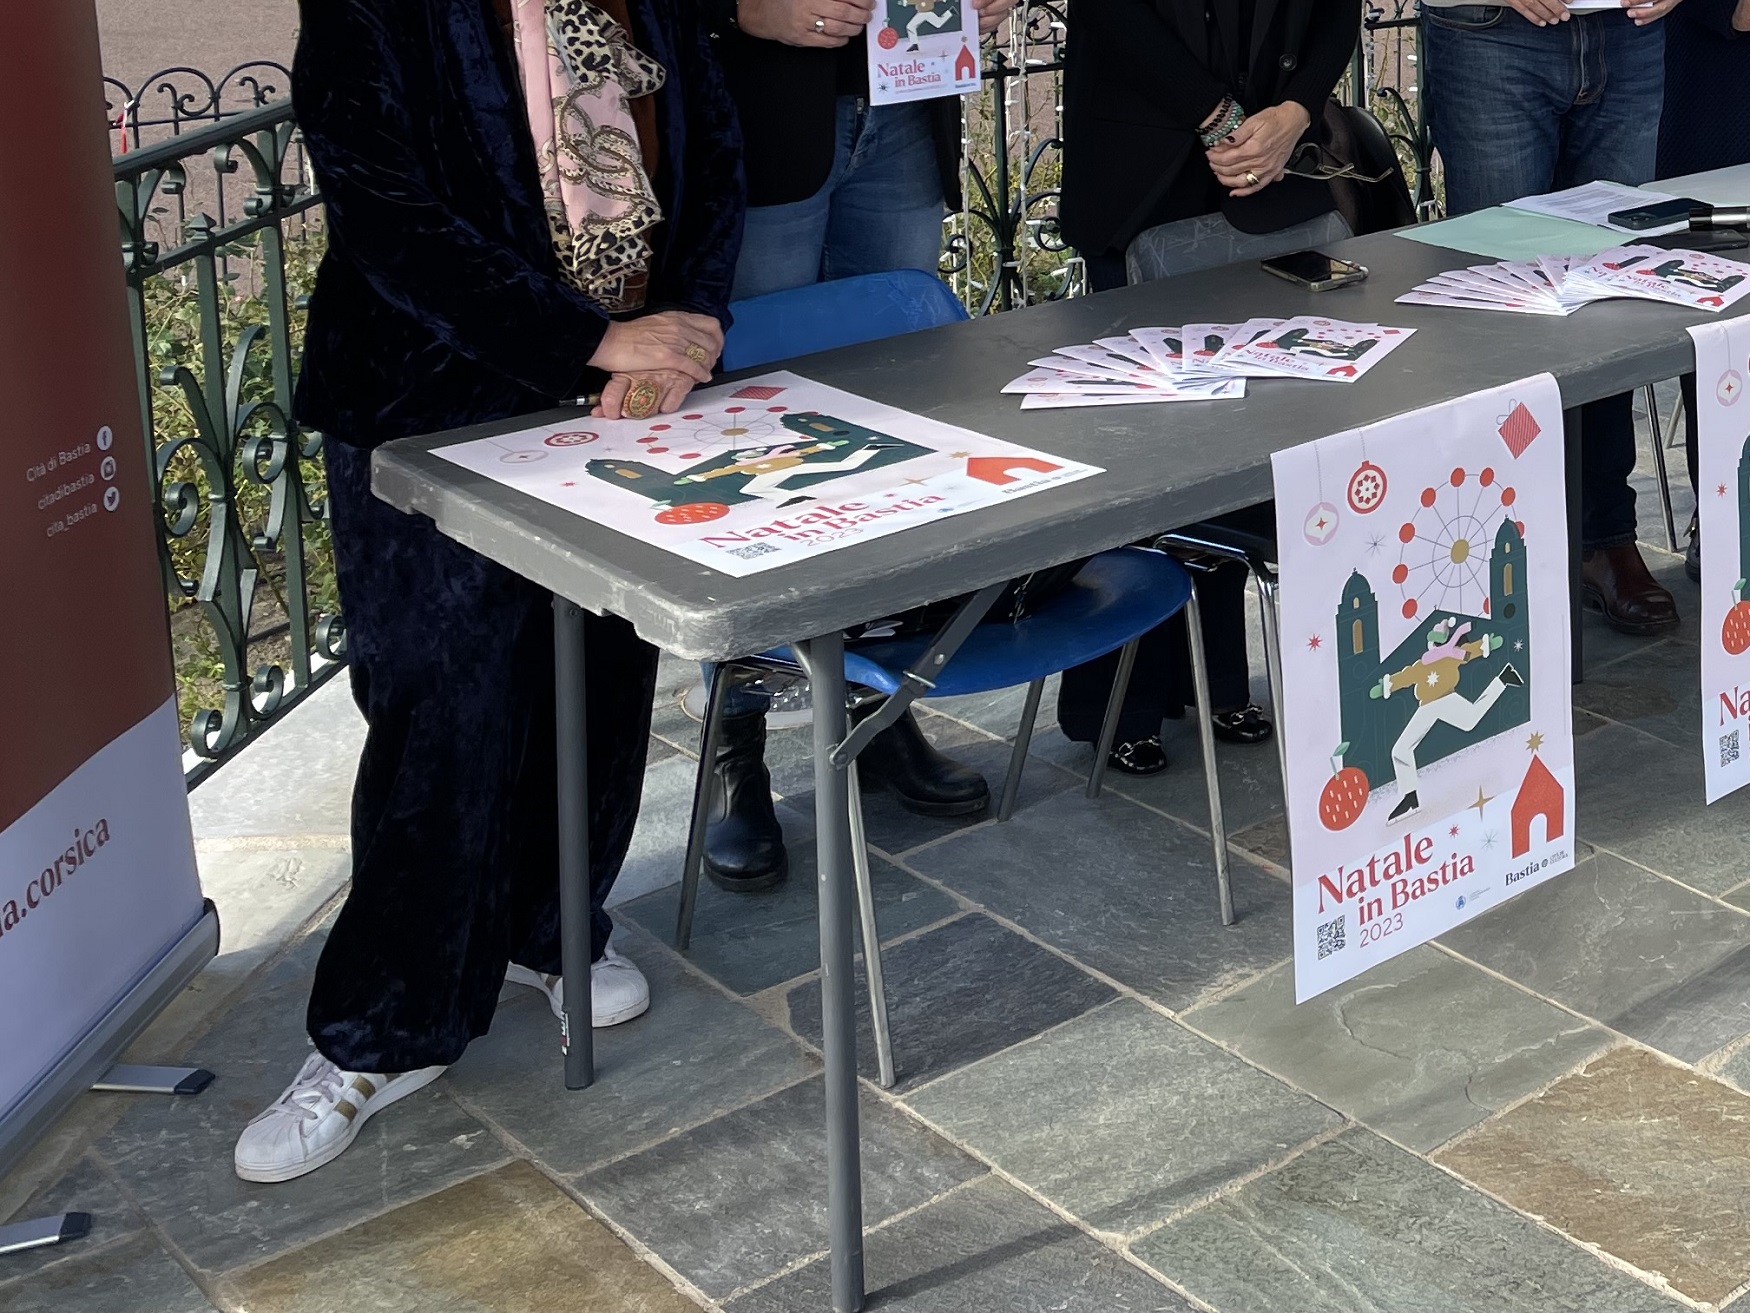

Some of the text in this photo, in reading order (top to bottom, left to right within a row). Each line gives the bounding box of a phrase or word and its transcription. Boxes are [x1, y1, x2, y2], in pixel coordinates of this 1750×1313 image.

[877, 59, 925, 78] Natale
[894, 76, 906, 88] in
[907, 71, 942, 86] Bastia
[47, 457, 57, 471] di
[58, 443, 91, 465] Bastia
[700, 502, 870, 549] Natale
[777, 492, 946, 543] in Bastia
[799, 526, 865, 547] 2023
[1317, 832, 1434, 914] Natale
[1504, 861, 1541, 886] Bastia
[1358, 852, 1475, 926] in Bastia
[1359, 913, 1404, 948] 2023
